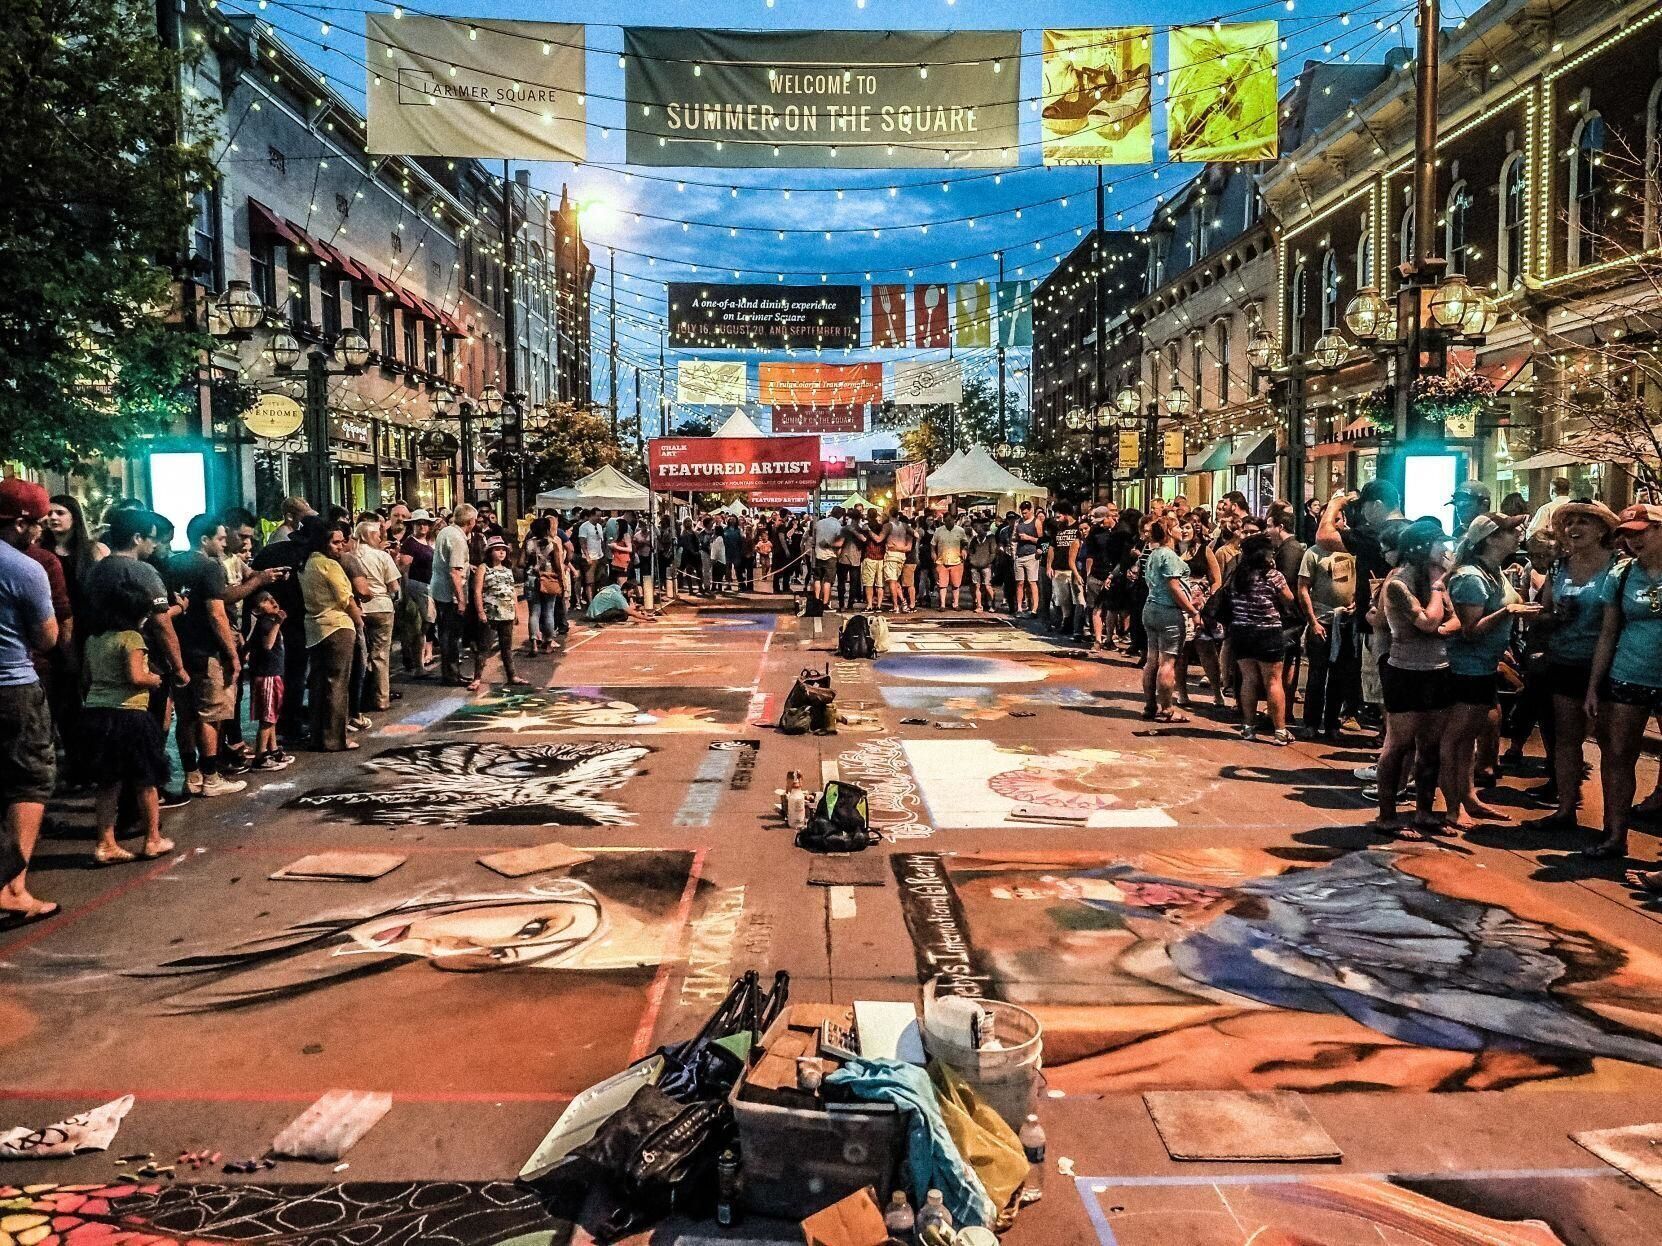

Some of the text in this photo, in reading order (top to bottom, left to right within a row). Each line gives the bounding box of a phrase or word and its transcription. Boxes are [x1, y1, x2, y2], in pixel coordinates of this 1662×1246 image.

[423, 82, 556, 102] LARIMER SQUARE
[768, 74, 877, 94] WELCOME TO
[667, 102, 978, 134] SUMMER ON THE SQUARE
[692, 298, 837, 311] A one-of-a-kind dining experience
[723, 312, 806, 323] on Larimer Square
[769, 326, 786, 336] AND
[790, 326, 840, 336] SEPTEMBER
[659, 461, 811, 476] FEATURED ARTIST
[904, 854, 942, 884] Realty
[919, 895, 970, 964] International
